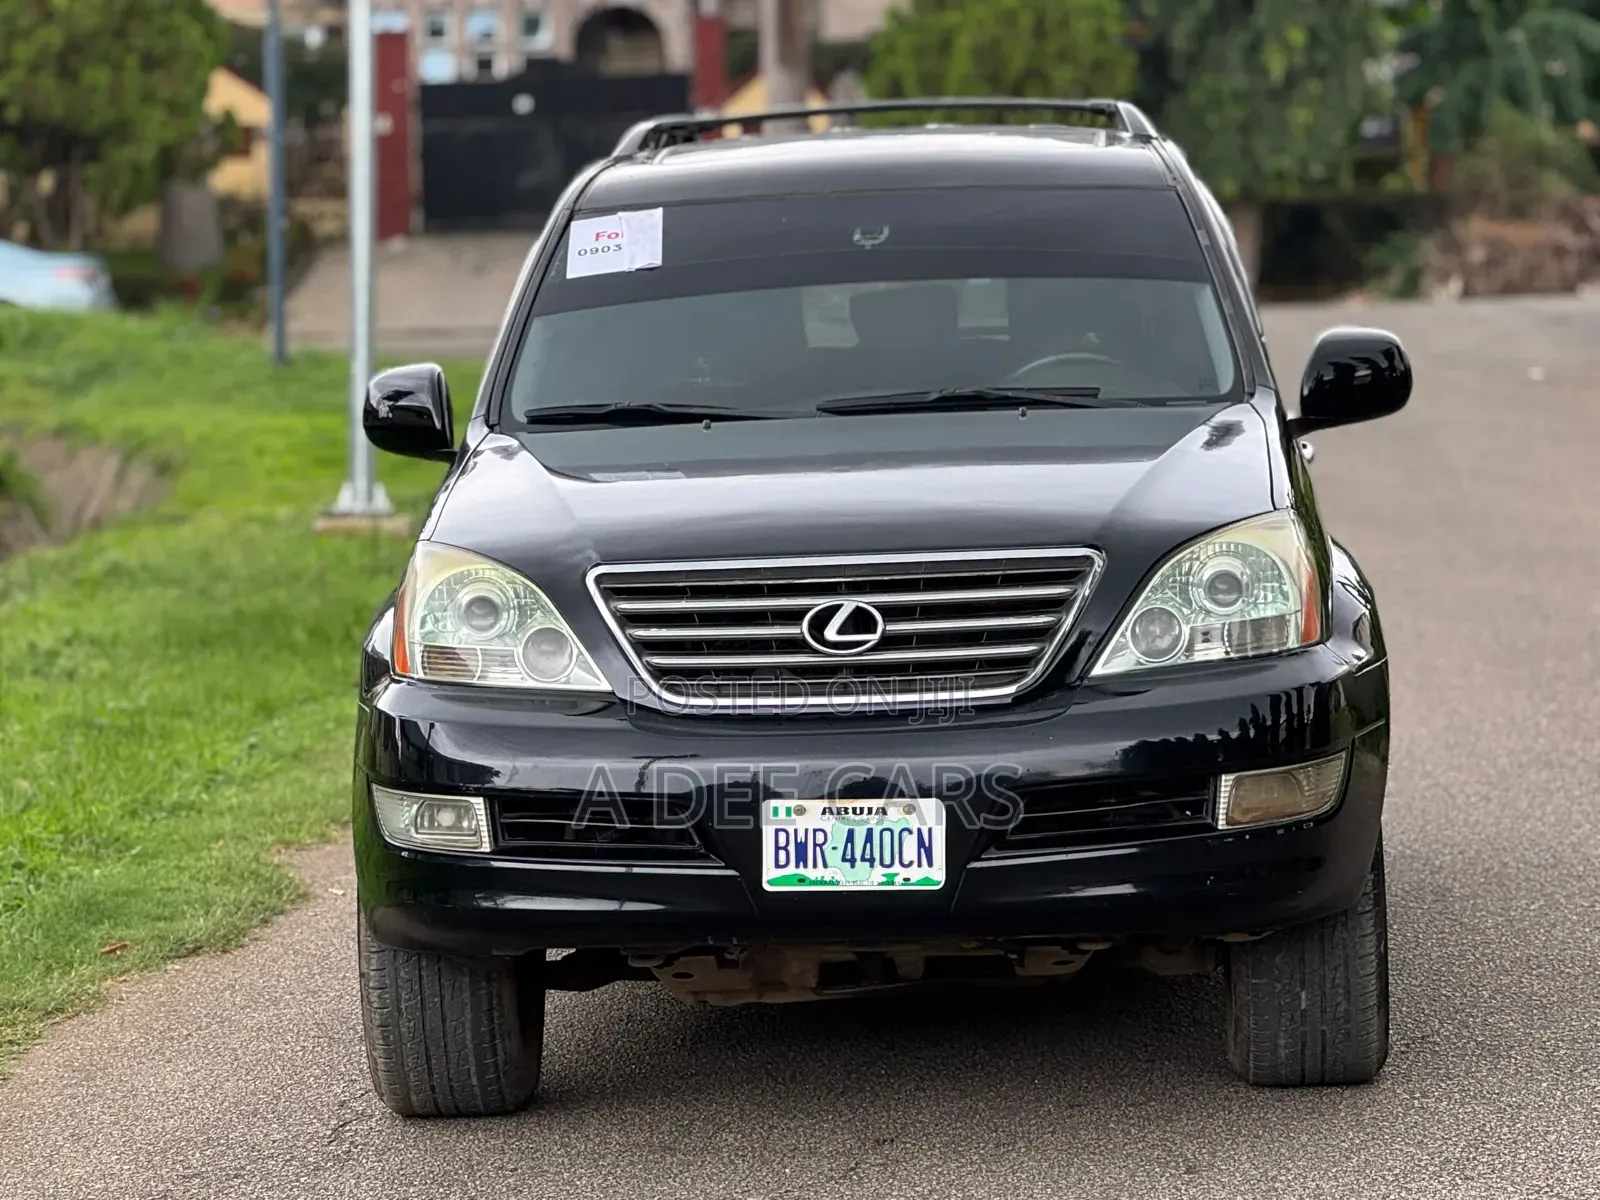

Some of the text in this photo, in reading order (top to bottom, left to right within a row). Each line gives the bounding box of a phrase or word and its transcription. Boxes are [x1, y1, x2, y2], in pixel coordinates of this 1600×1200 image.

[577, 243, 623, 257] 0903
[820, 806, 888, 816] ABUJA
[773, 826, 934, 870] BWR-440CN
